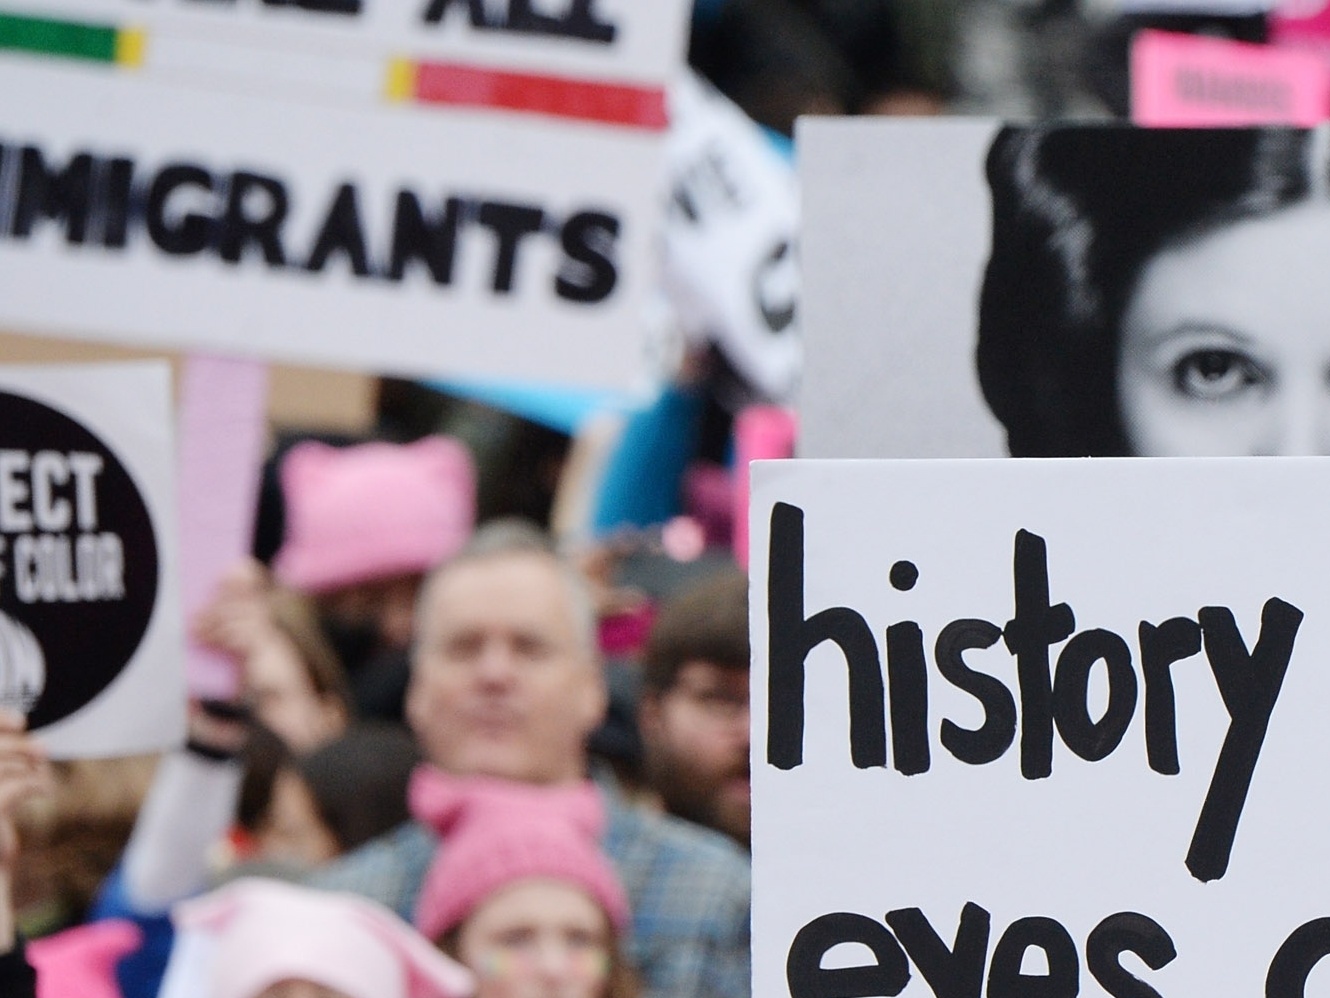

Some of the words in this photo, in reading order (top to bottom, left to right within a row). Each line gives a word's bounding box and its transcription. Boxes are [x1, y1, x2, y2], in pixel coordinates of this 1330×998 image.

[0, 143, 620, 304] MIGRANTS
[14, 531, 125, 603] COLOR
[767, 502, 1304, 882] history
